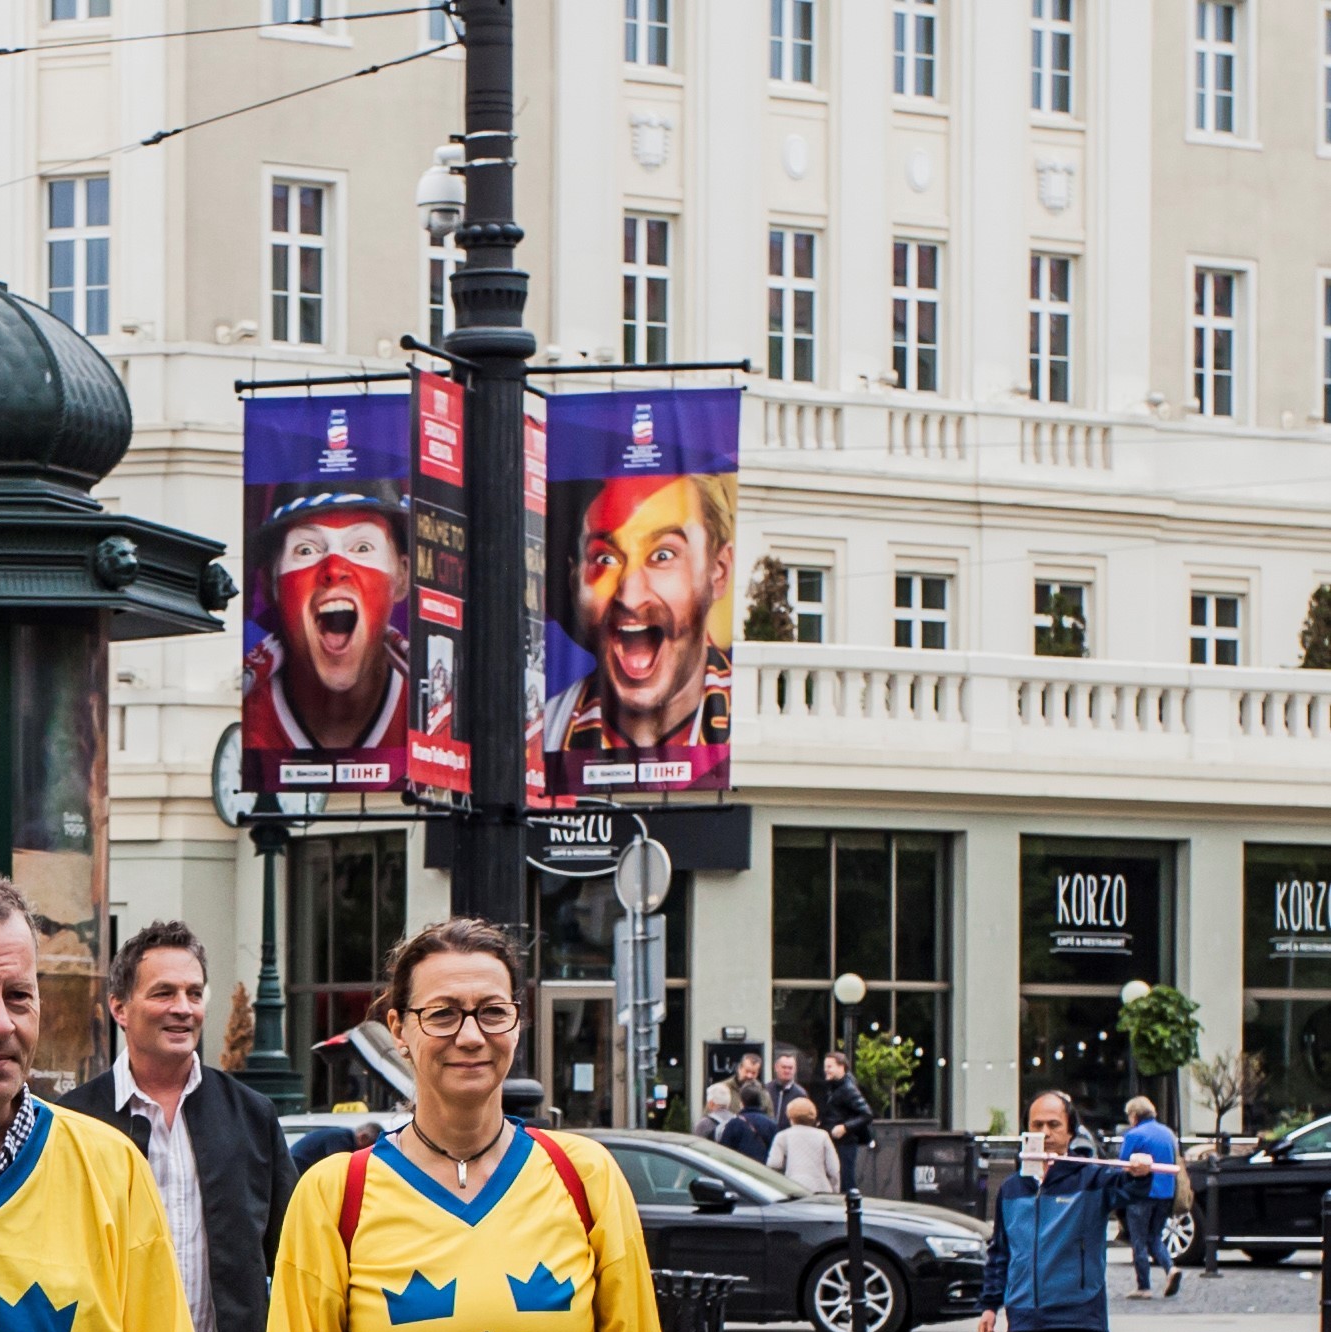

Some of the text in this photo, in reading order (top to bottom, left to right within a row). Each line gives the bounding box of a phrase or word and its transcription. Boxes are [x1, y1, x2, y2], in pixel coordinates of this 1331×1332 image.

[351, 767, 383, 779] IIHF
[654, 765, 685, 778] IIHF
[1057, 873, 1127, 927] KORZO
[1275, 880, 1331, 932] KORZ
